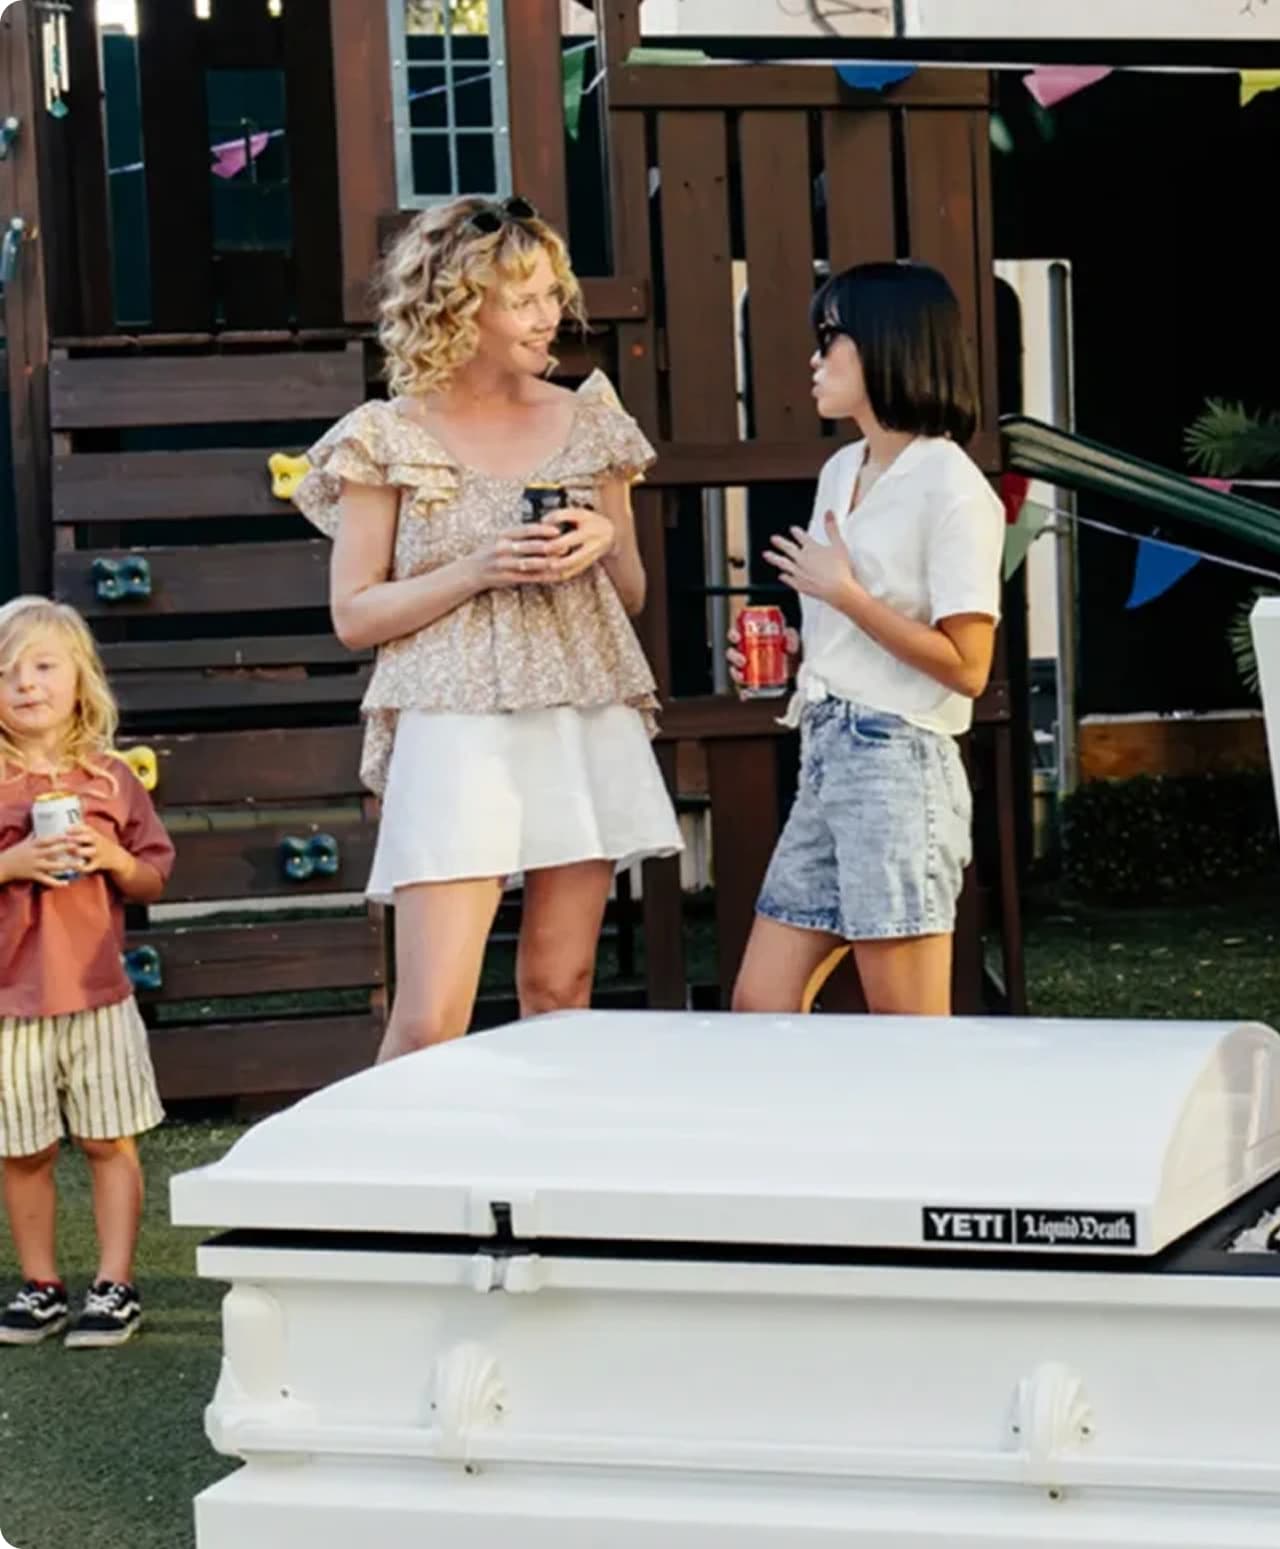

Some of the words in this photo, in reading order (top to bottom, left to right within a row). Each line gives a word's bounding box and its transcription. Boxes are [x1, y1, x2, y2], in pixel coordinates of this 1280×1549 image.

[928, 1212, 1006, 1239] YETI
[1022, 1213, 1079, 1244] Liquid
[1079, 1215, 1132, 1240] Death
